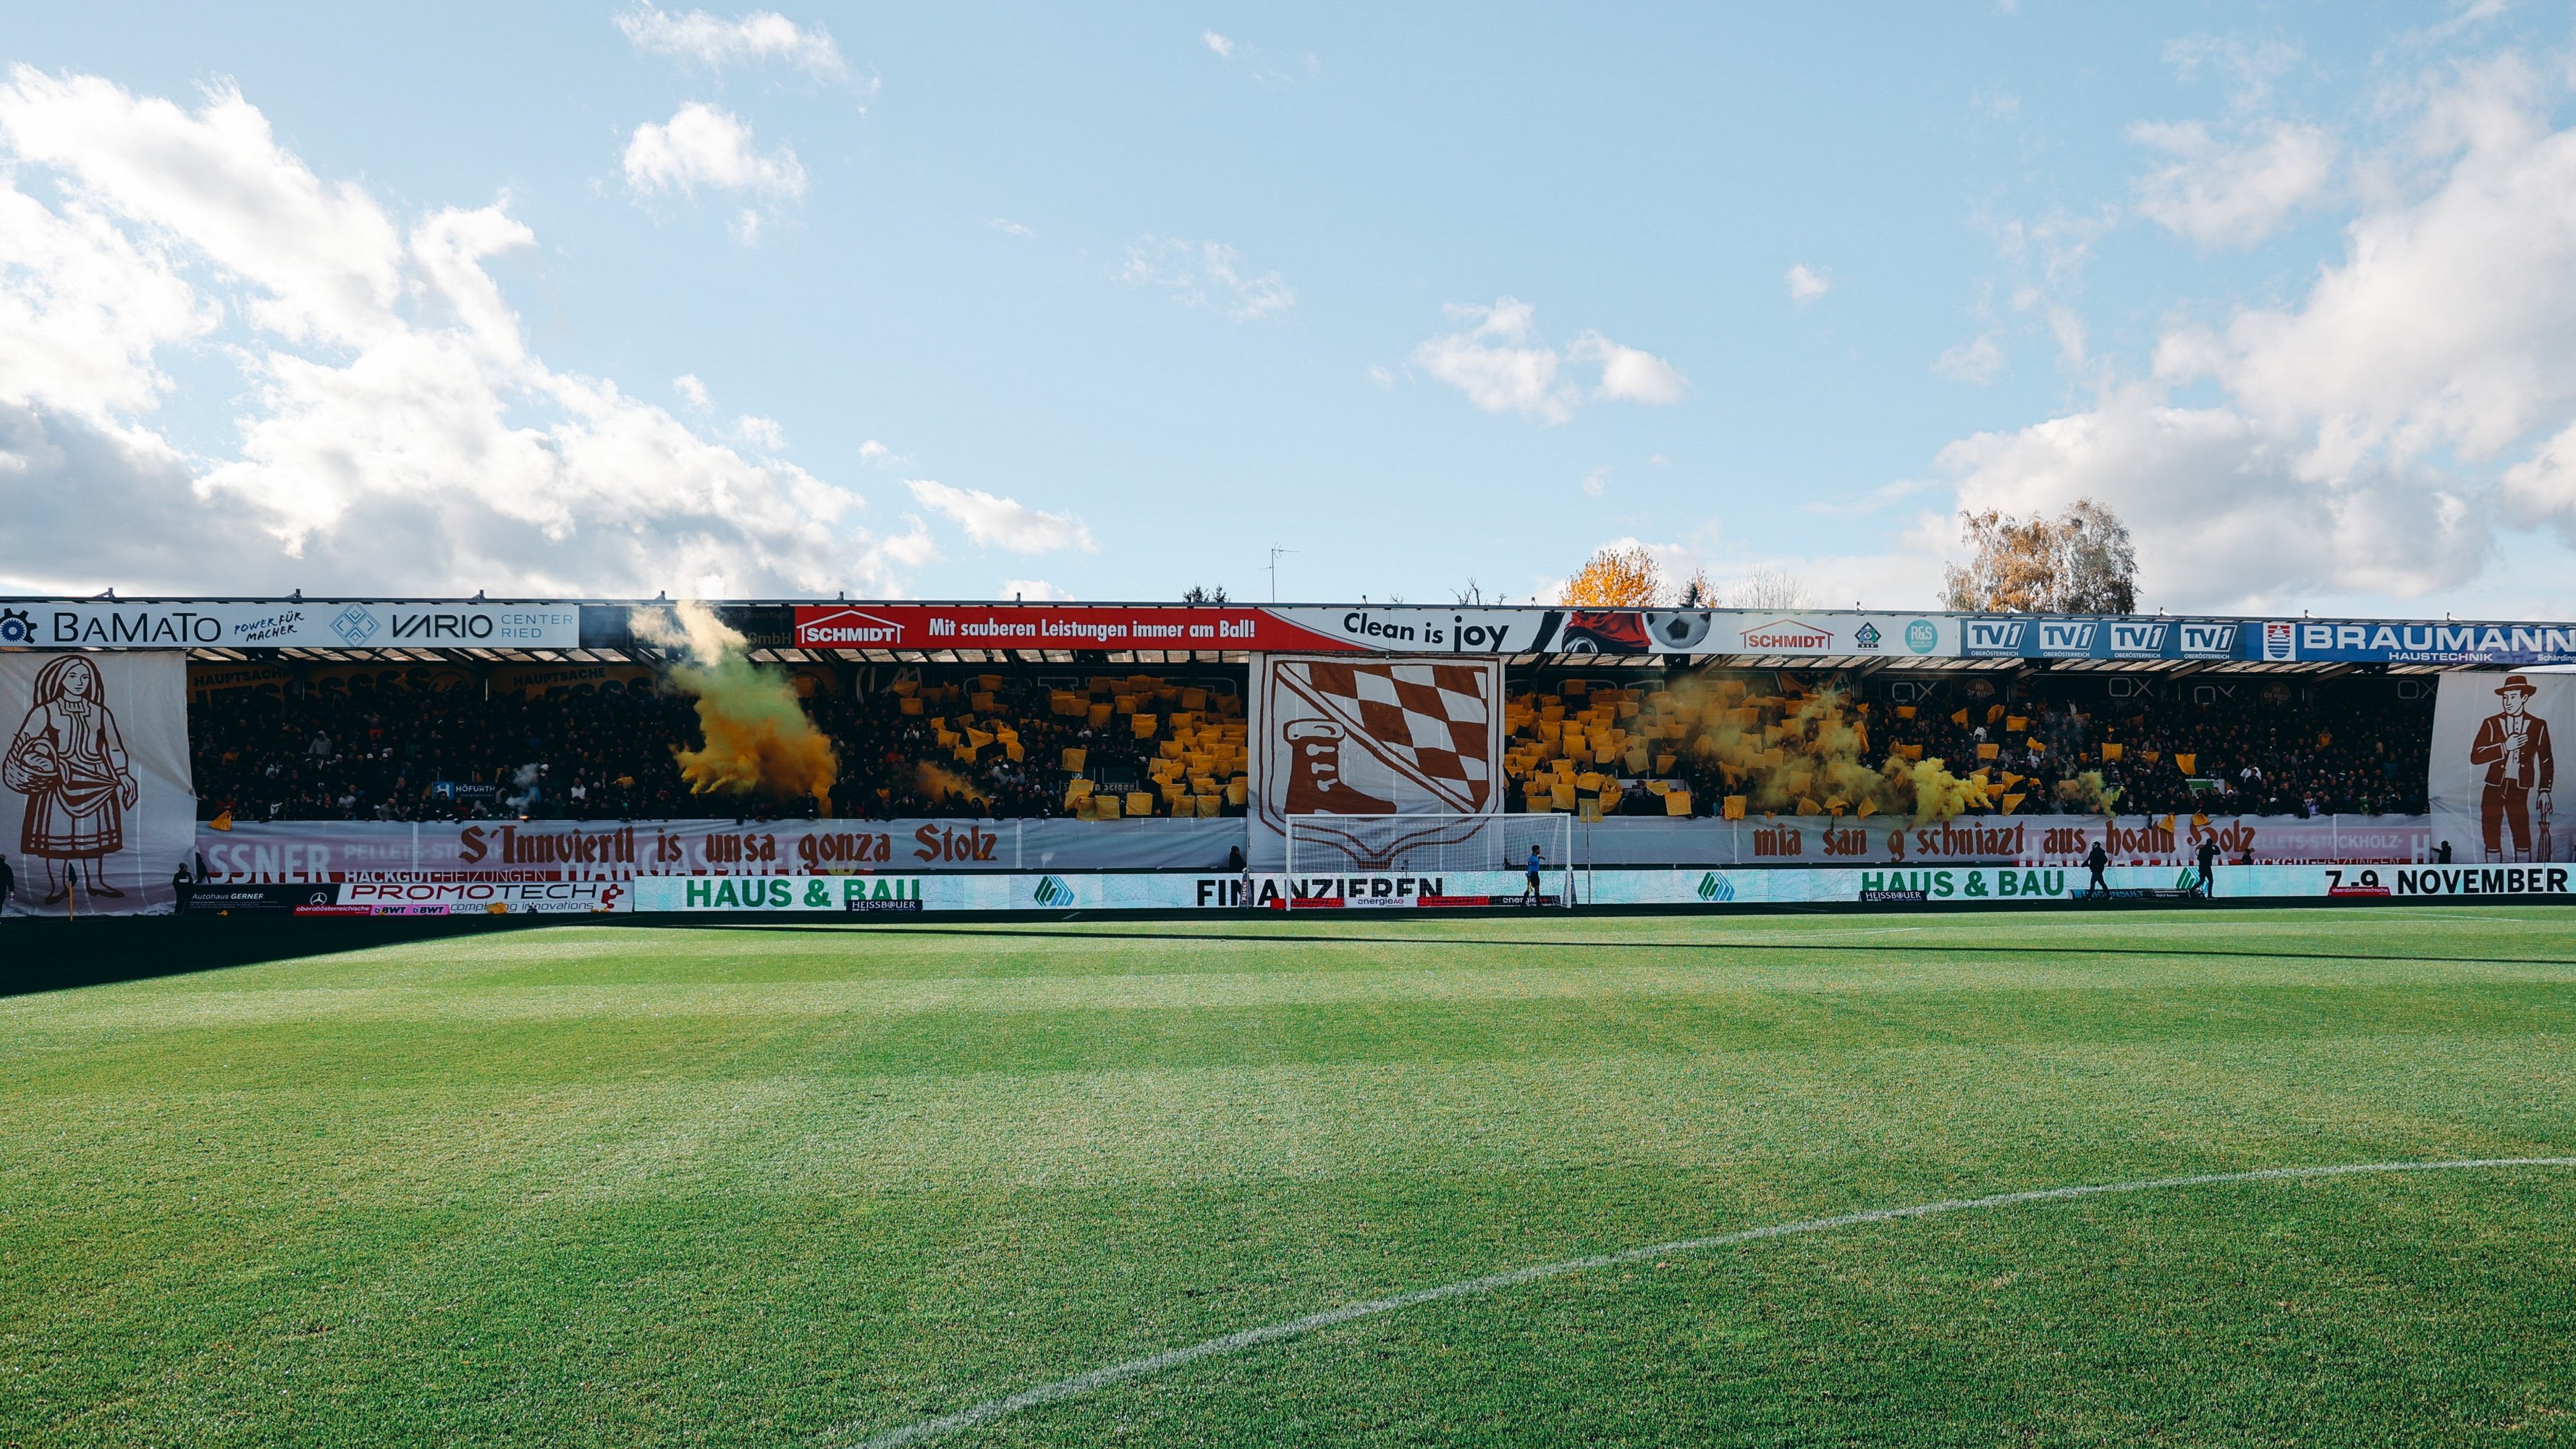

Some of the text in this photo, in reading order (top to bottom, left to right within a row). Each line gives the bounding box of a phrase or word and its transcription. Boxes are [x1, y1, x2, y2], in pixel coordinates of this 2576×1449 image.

[234, 610, 304, 635] POWER FÜR
[392, 614, 493, 638] VARIO
[502, 614, 573, 625] CENTER
[929, 617, 1255, 641] Mit sauberen Leistungen immer am Ball!
[246, 625, 298, 642] MACHER
[502, 628, 541, 638] RIED
[748, 632, 792, 645] GmbH
[807, 628, 895, 642] SCHMIDT
[1343, 612, 1510, 651] Clean is joy
[1749, 635, 1825, 649] SCHMIDT
[1911, 625, 1933, 641] R&S
[1972, 625, 2022, 646] TV1
[2043, 626, 2093, 646] TV1
[2115, 627, 2163, 647] TV1
[2184, 628, 2232, 649] TV1
[2303, 625, 2576, 652] BRAUMANN
[2389, 652, 2494, 662] HAUSTECHNIK
[513, 667, 606, 686] HAUPTSACHE
[2108, 677, 2154, 698] OX
[656, 827, 683, 862] is
[706, 832, 776, 863] unsa
[798, 832, 891, 870] gonza
[913, 823, 998, 863] Stolz
[1753, 822, 1802, 856] mia
[1822, 827, 1867, 856] san
[2043, 827, 2087, 855] aus
[351, 884, 596, 900] PROMOTECH
[1197, 878, 1443, 906] FINANZIEREN
[1862, 871, 2064, 897] HAUS & BAU
[2398, 869, 2568, 895] NOVEMBER
[687, 878, 920, 908] HAUS & BAU
